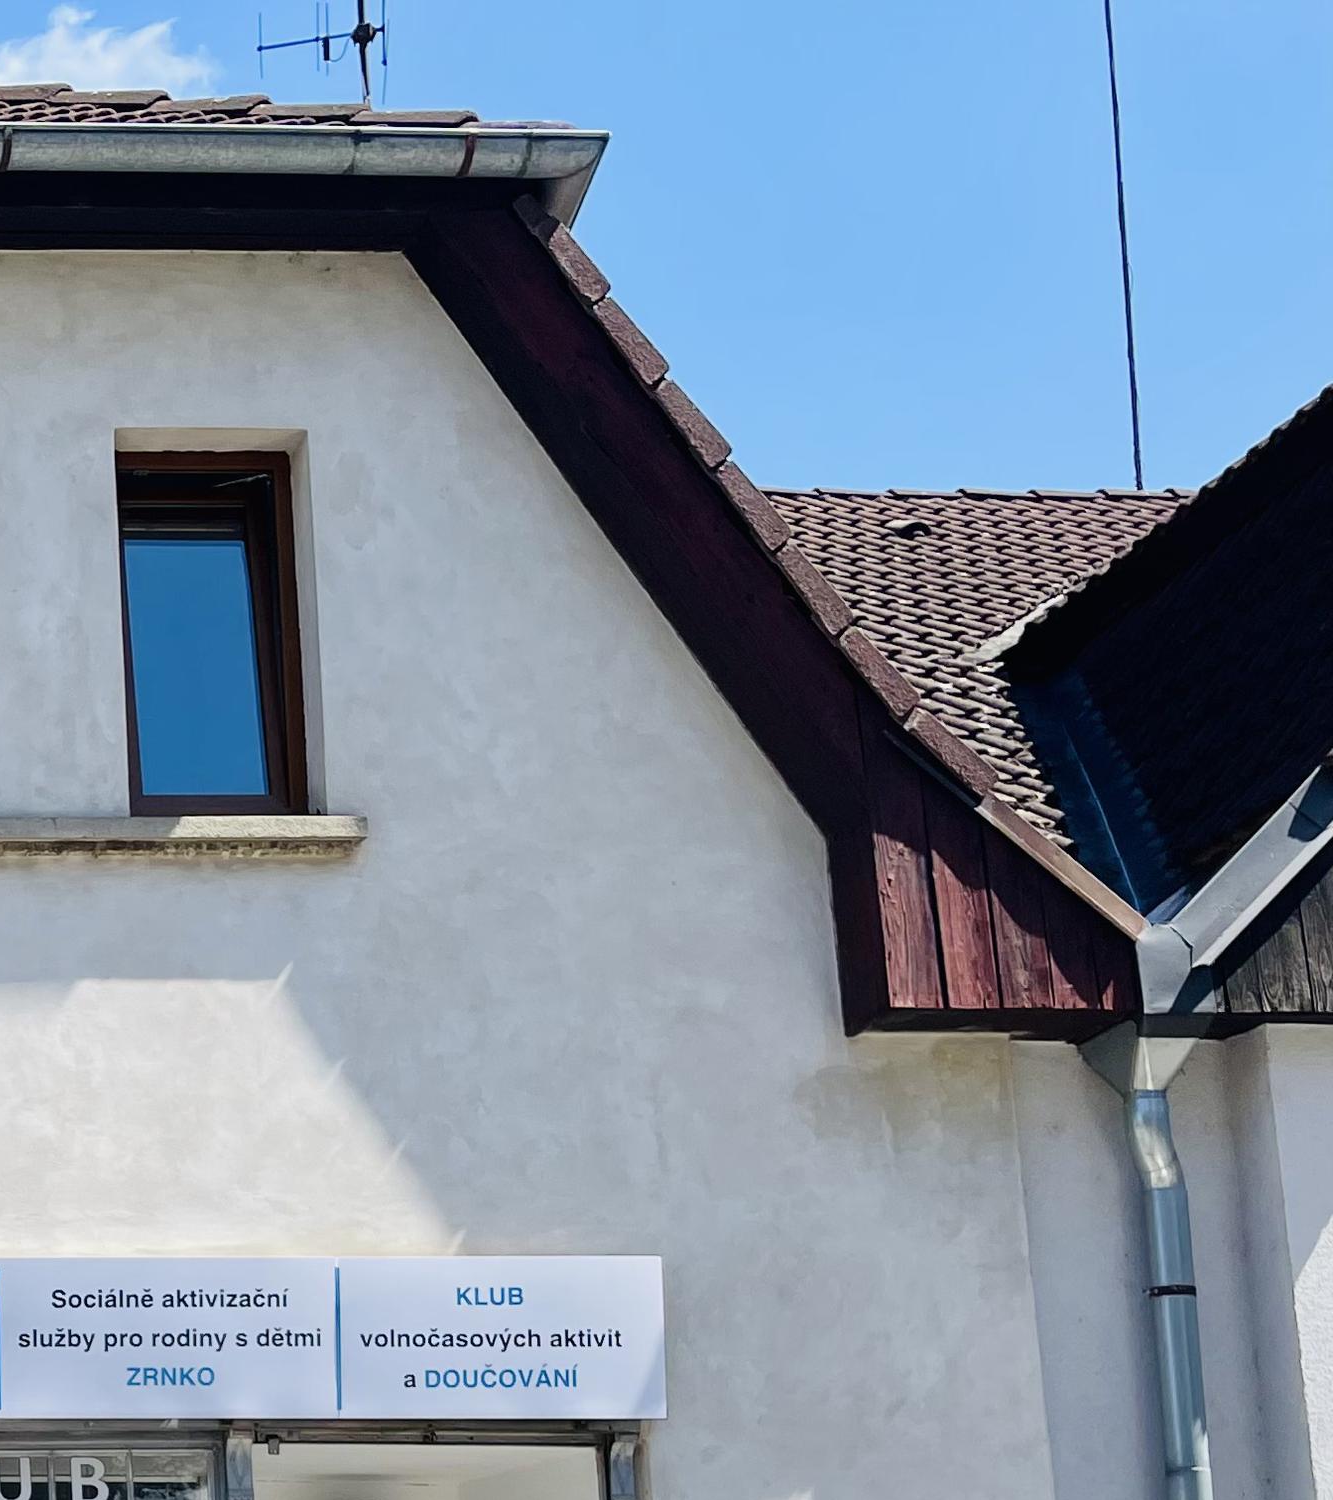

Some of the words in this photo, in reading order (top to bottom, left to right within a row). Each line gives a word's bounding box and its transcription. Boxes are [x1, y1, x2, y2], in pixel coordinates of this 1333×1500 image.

[51, 1288, 154, 1309] Sociálně
[161, 1288, 289, 1308] aktivizační
[456, 1286, 525, 1306] KLUB
[18, 1328, 95, 1352] služby
[103, 1332, 144, 1352] pro
[151, 1328, 227, 1352] rodiny
[235, 1332, 248, 1348] s
[256, 1327, 322, 1348] dětmi
[359, 1328, 542, 1352] volnočasových
[549, 1328, 623, 1348] aktivit
[126, 1366, 216, 1386] ZRNKO
[403, 1373, 417, 1388] a
[424, 1362, 579, 1389] DOUČOVÁNÍ
